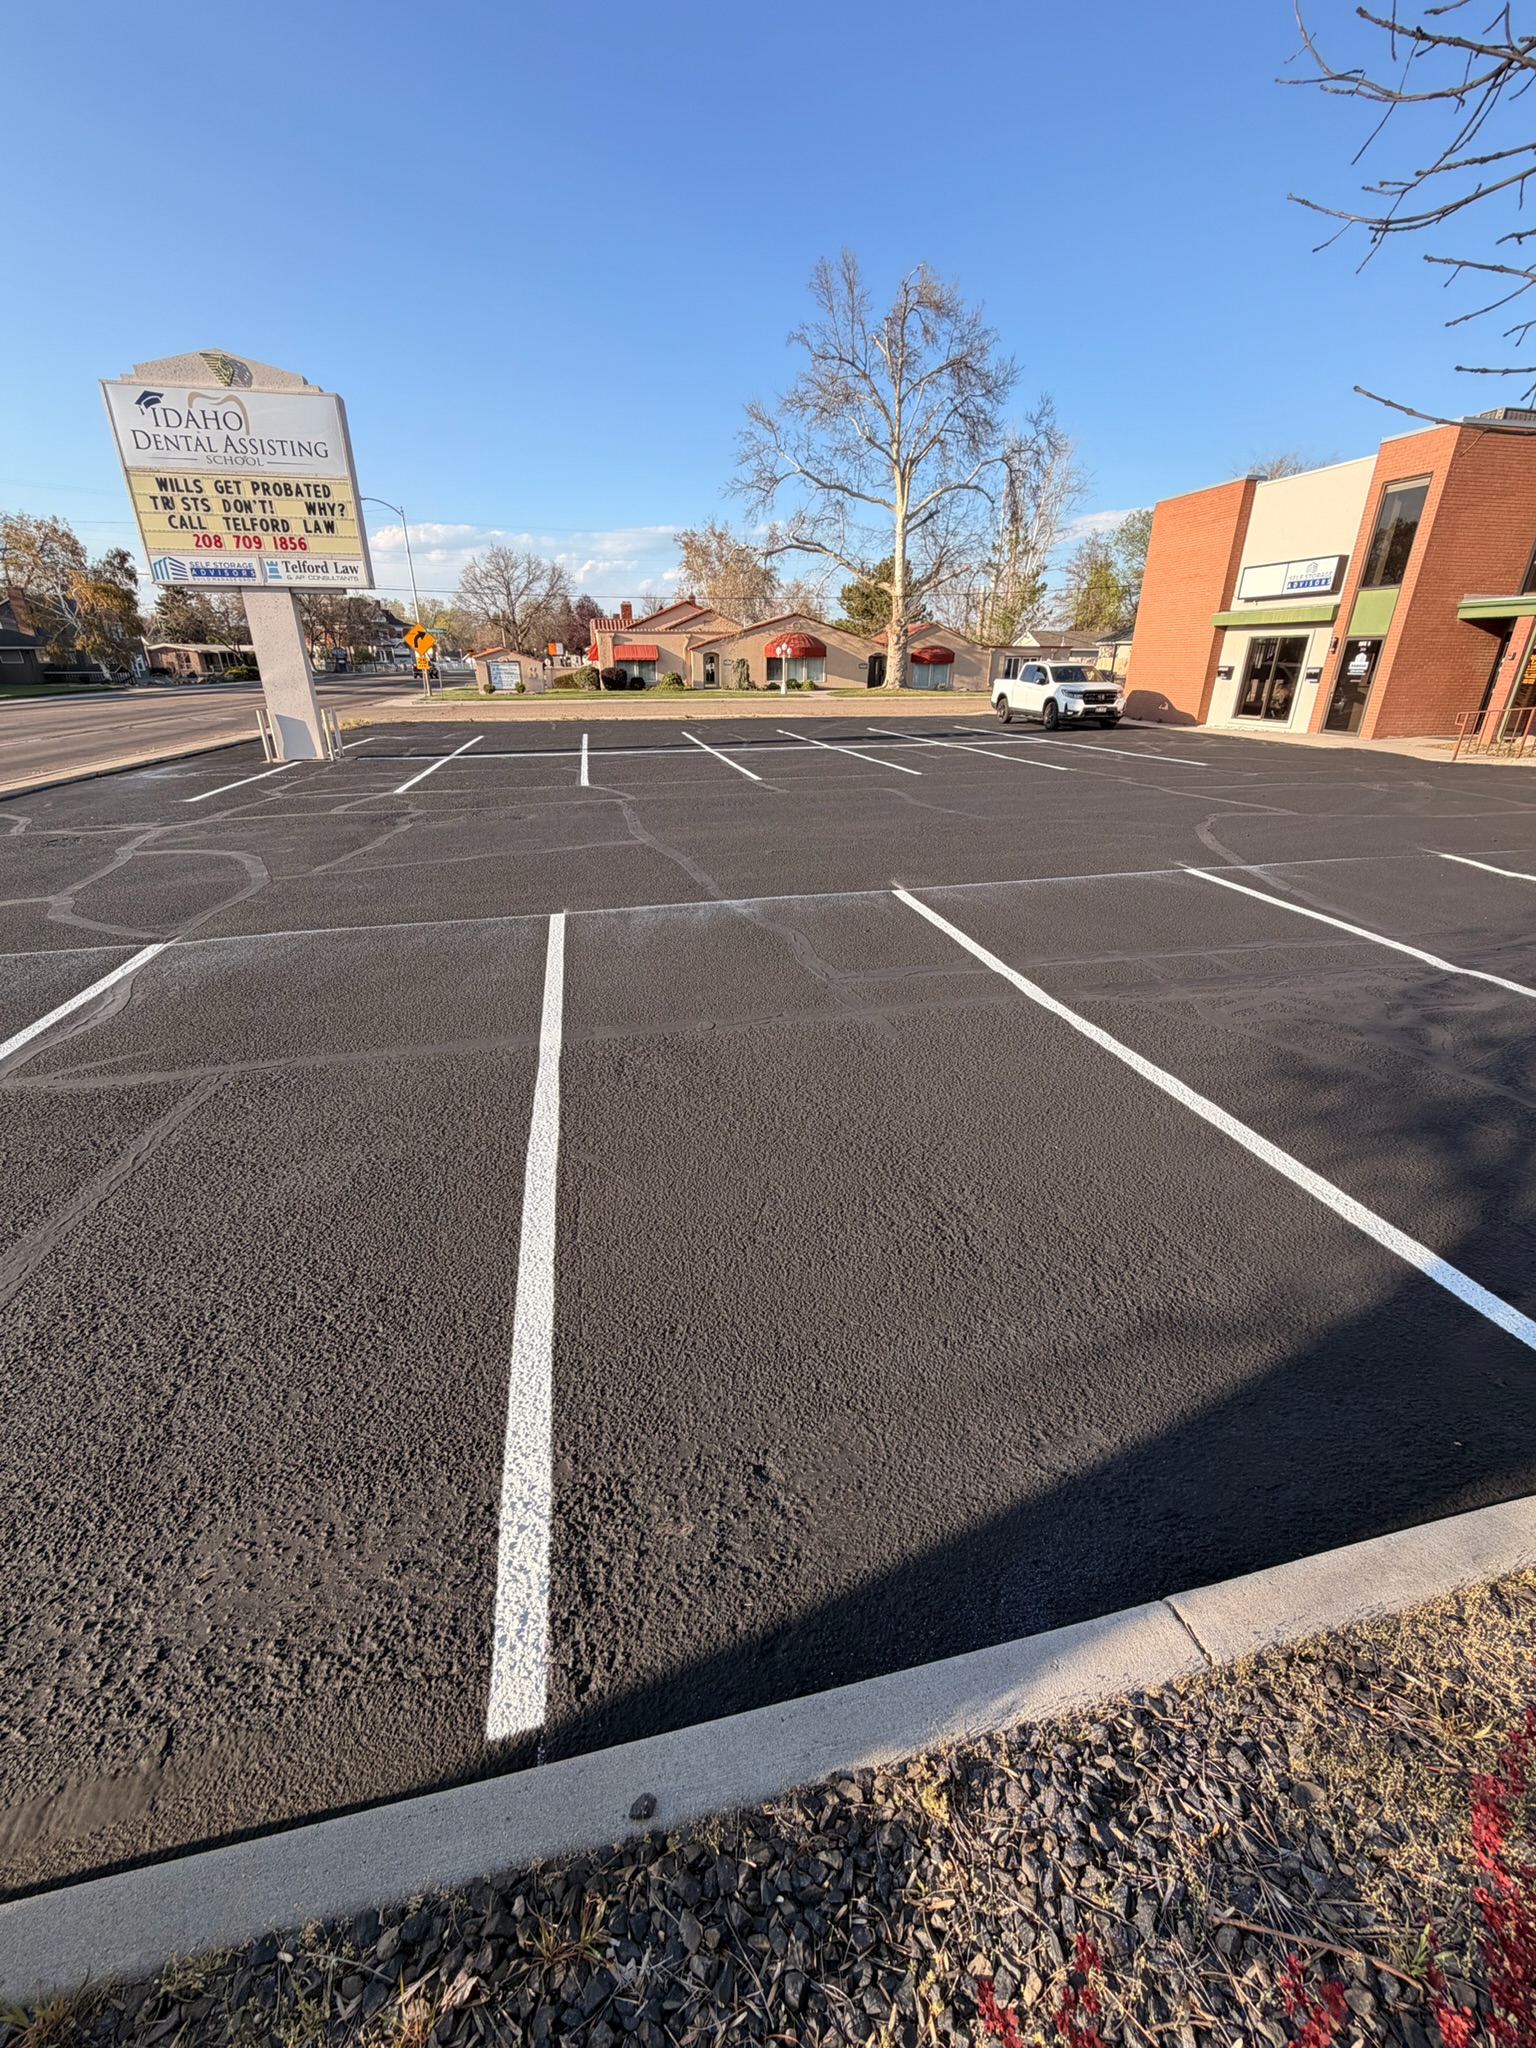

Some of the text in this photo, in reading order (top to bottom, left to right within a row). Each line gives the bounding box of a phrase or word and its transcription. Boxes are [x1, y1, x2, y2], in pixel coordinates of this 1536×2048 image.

[151, 407, 243, 432] IDAHO
[130, 429, 329, 459] DENTAL ASSISTING
[206, 454, 264, 466] SCHOOL
[155, 477, 331, 498] WILLS GET PROBATED
[222, 499, 274, 514] DON'T!
[304, 502, 346, 517] WHY?
[167, 515, 335, 534] CALL TELFORD LAW
[192, 534, 308, 551] 208 709 1856
[191, 569, 256, 577] ADVISORS
[281, 560, 359, 575] Telford Law
[1287, 578, 1332, 590] ADVISORS
